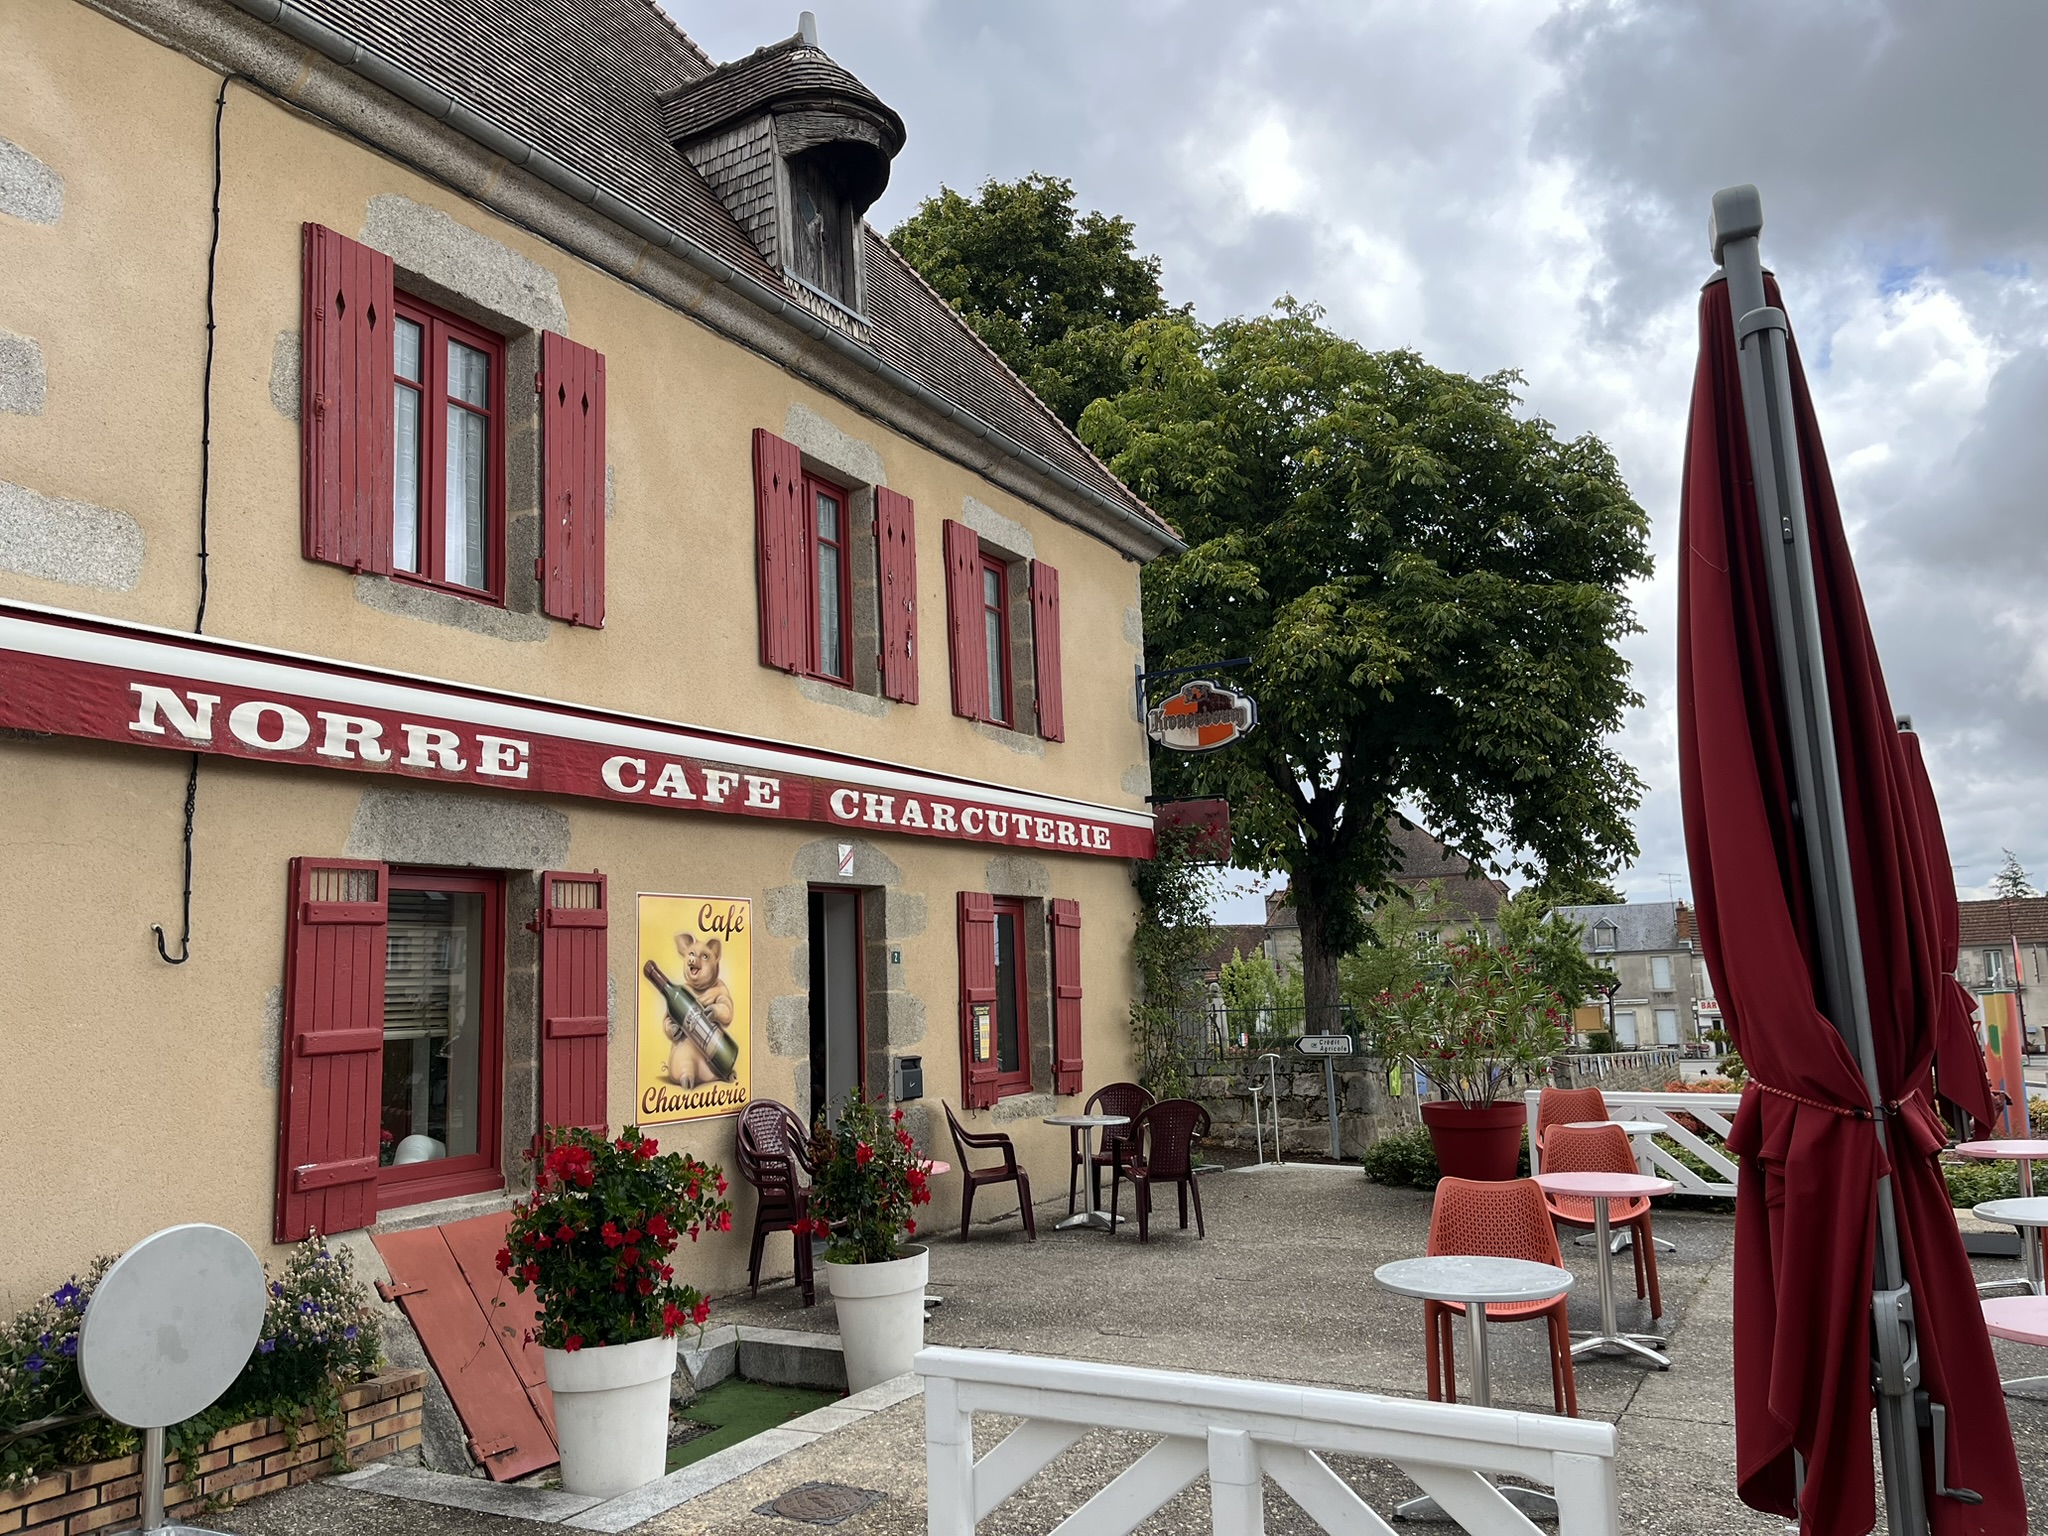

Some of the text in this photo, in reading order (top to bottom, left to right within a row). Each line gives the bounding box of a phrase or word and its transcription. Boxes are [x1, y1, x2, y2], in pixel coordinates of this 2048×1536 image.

[1151, 705, 1247, 732] Kronenbourg
[129, 683, 1111, 850] NORRE CAFE CHARCUTERIE
[698, 903, 745, 941] Café
[642, 1082, 746, 1114] Charcuterie
